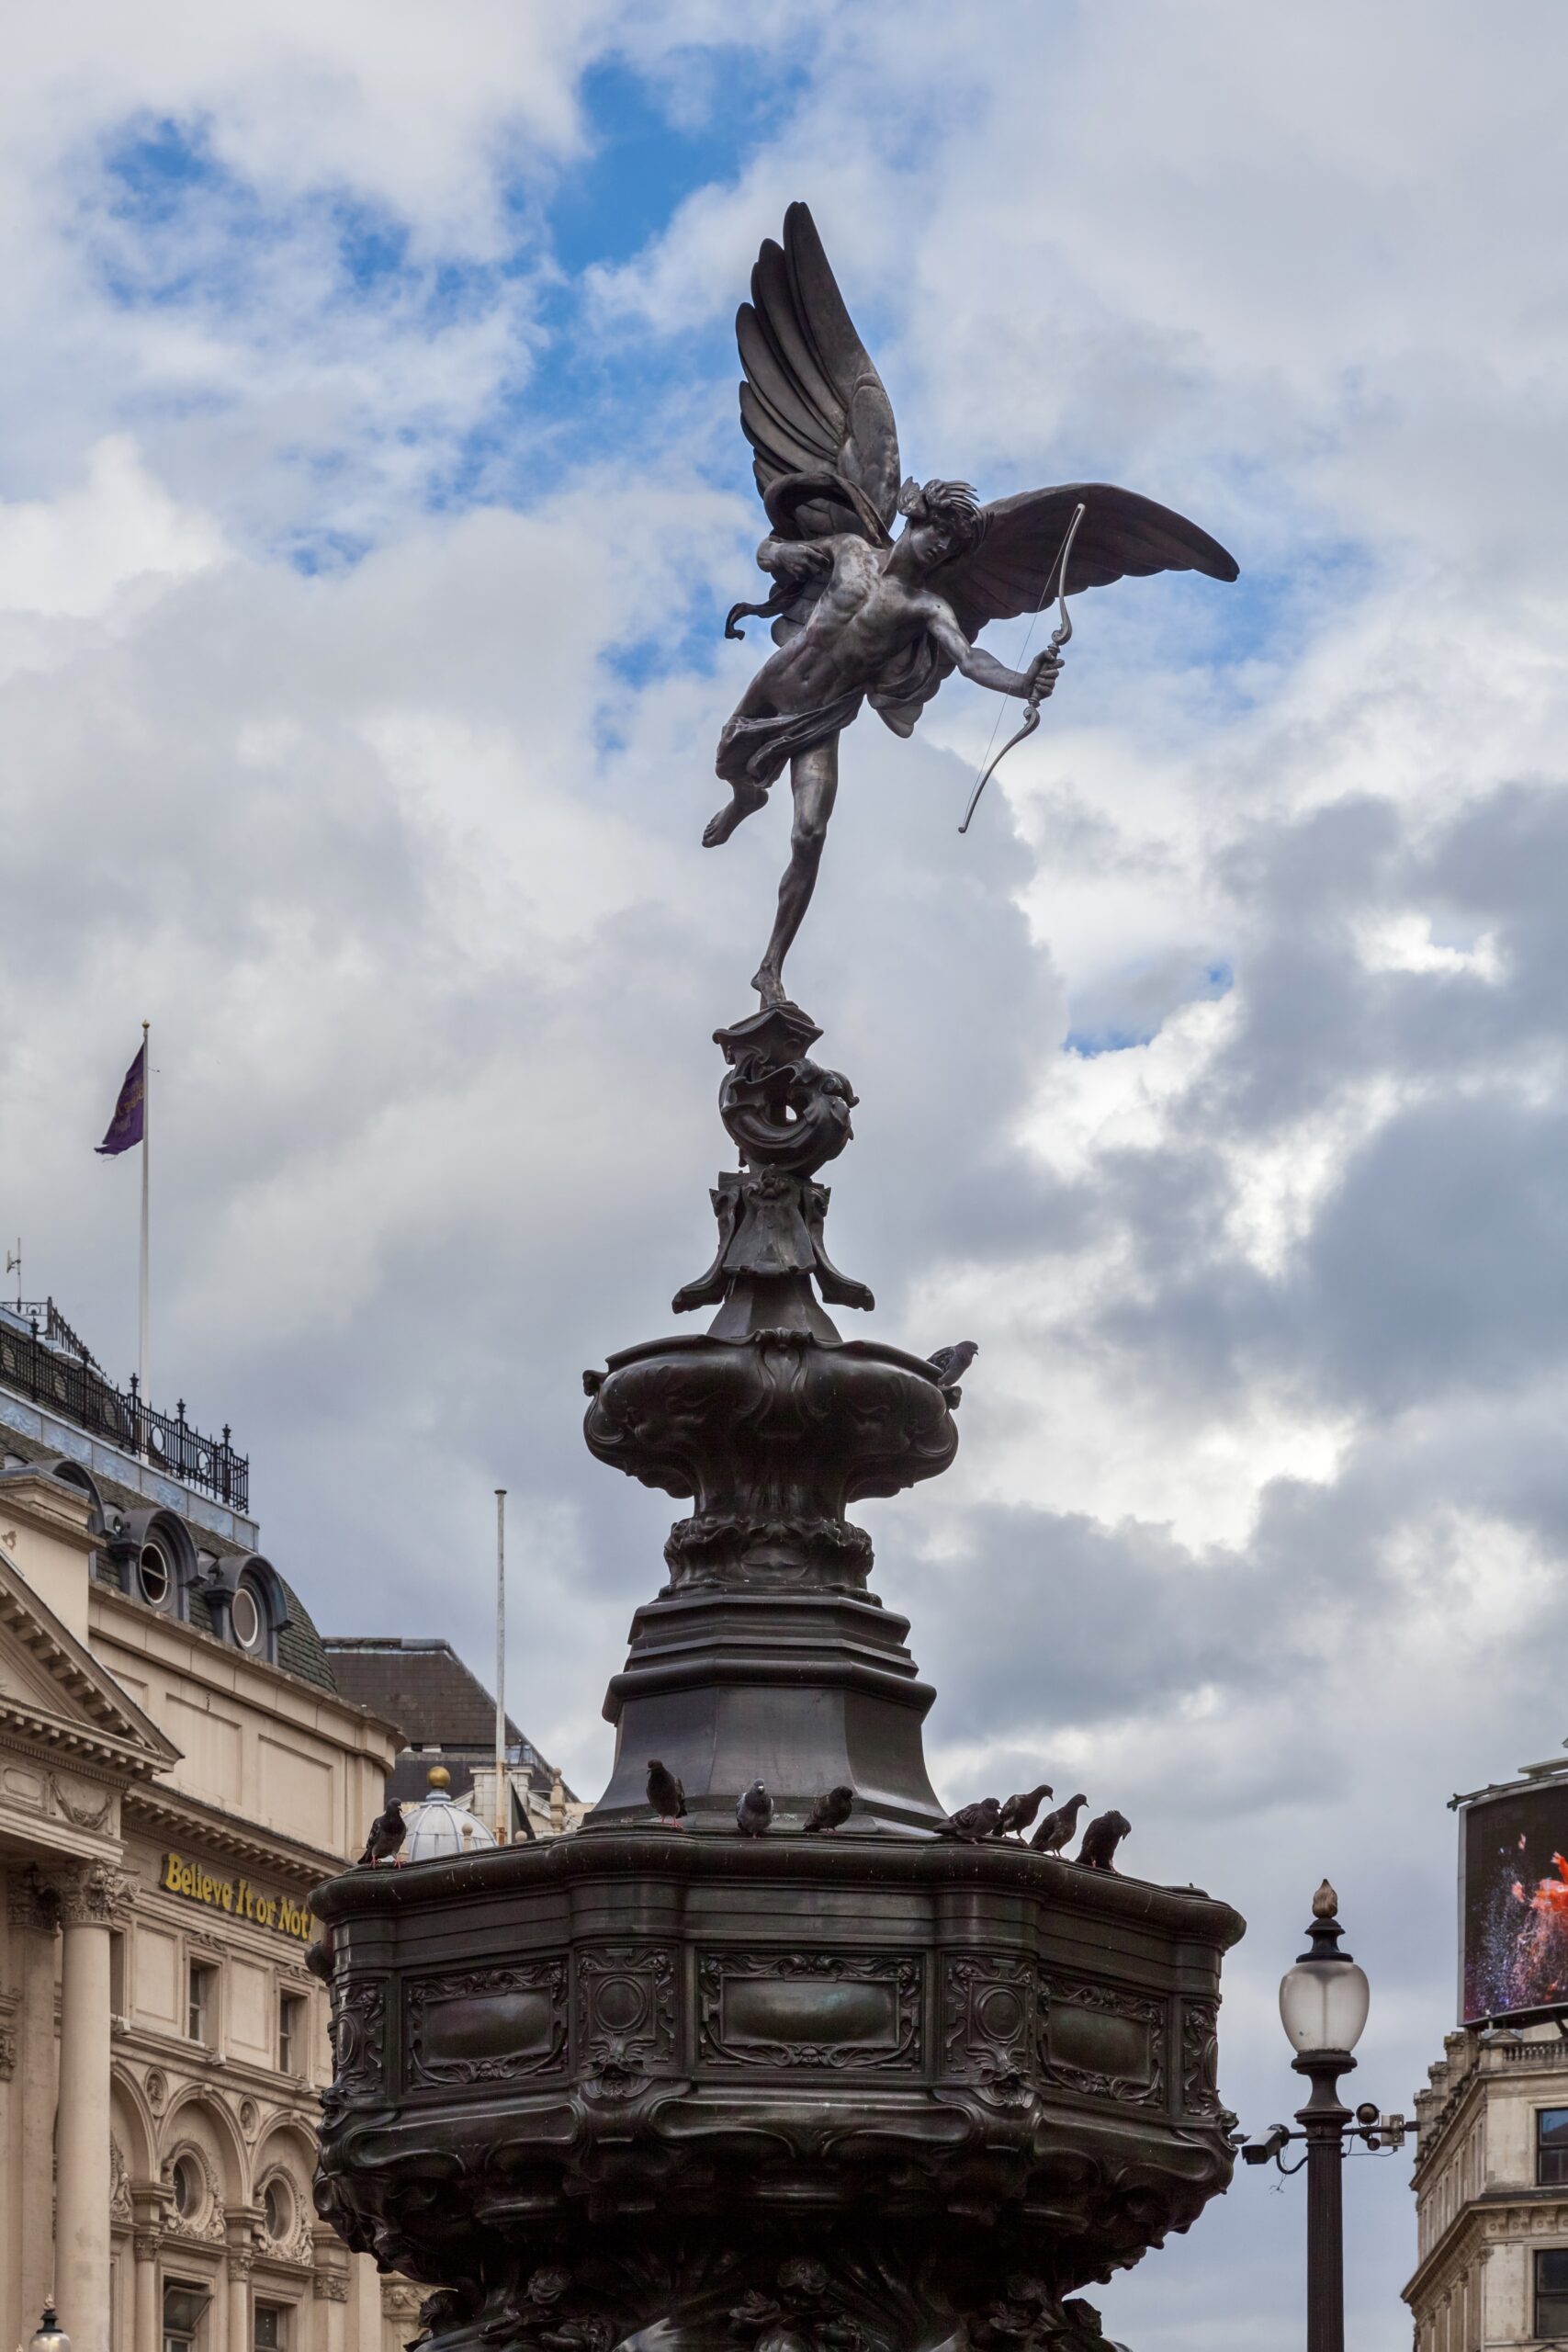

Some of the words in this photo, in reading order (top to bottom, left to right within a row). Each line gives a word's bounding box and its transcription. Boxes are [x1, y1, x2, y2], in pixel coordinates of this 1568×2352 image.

[165, 1853, 233, 1910] Believe
[236, 1879, 254, 1919] It
[256, 1897, 276, 1927] or
[278, 1896, 315, 1942] Not!
